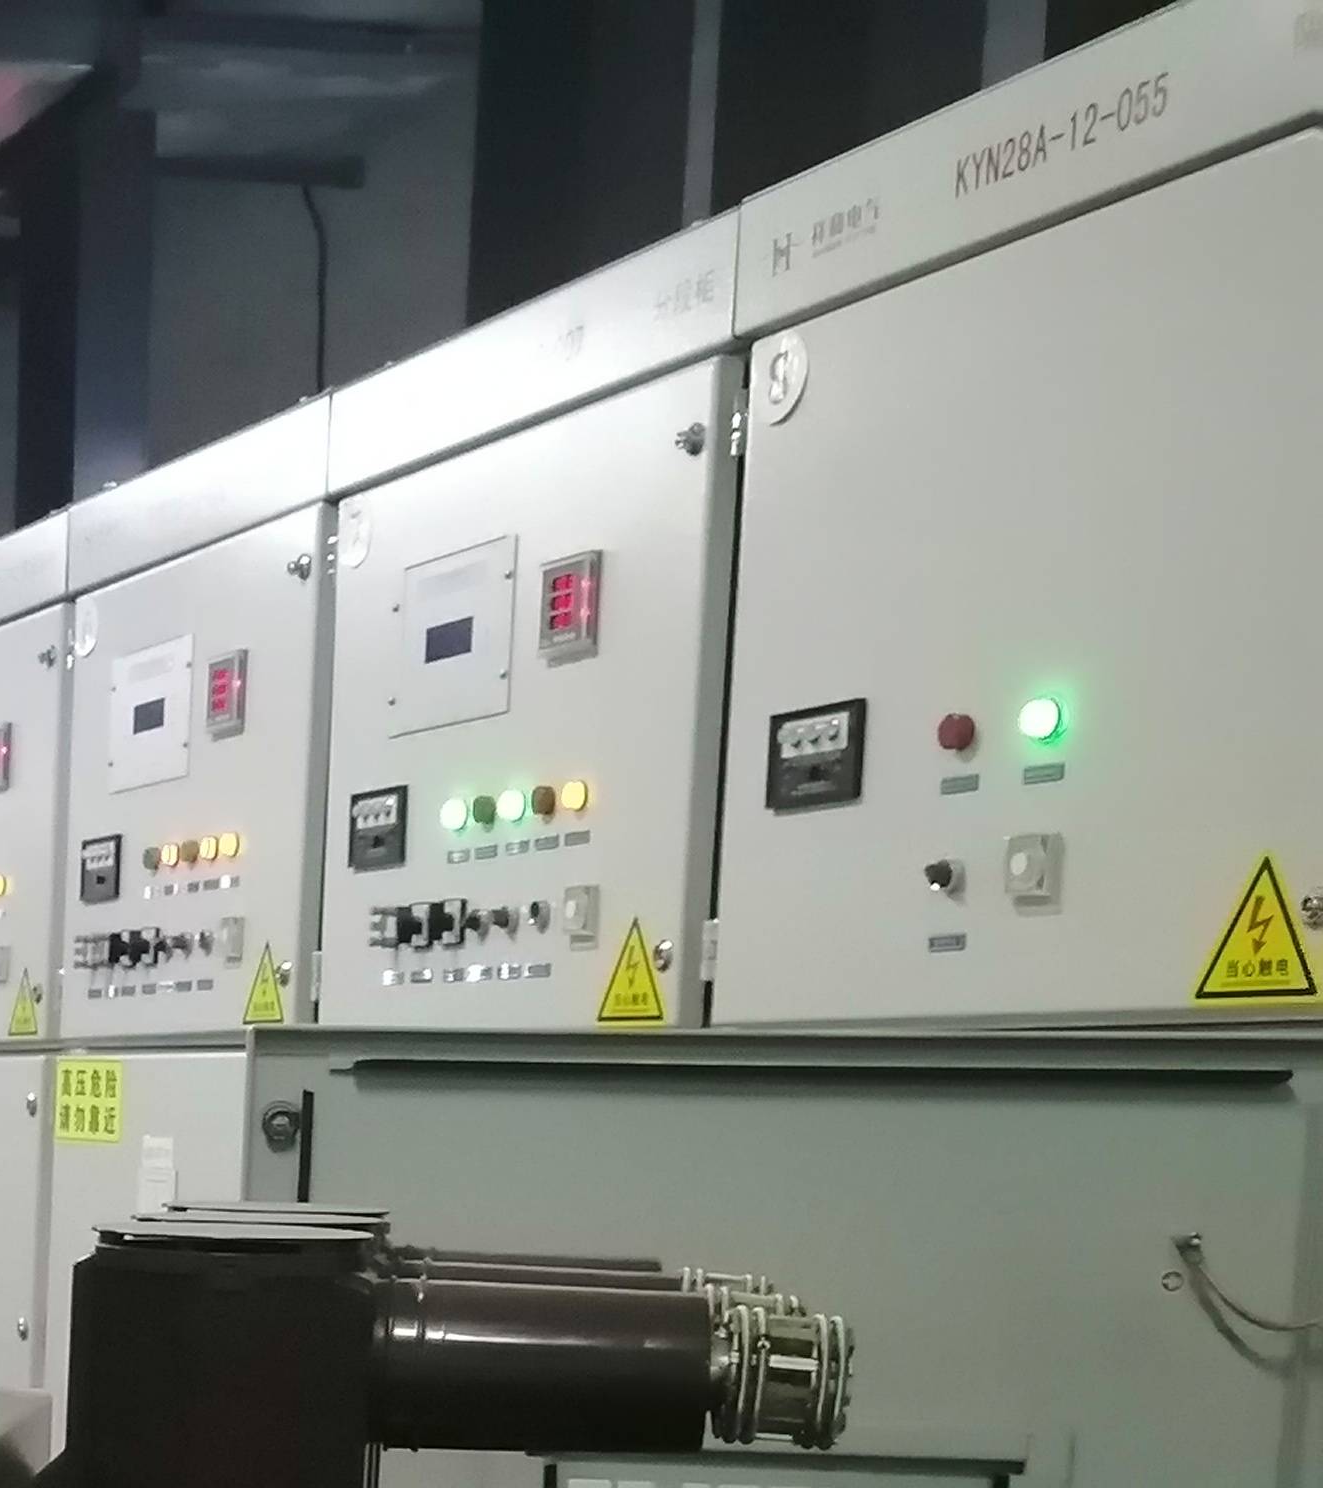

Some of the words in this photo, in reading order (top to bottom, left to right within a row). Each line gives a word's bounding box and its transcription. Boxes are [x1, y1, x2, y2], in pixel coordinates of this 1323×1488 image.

[955, 72, 1168, 198] KYN28A-12-055
[1226, 958, 1289, 978] 当心触电
[60, 1069, 117, 1098] 高压危险
[59, 1104, 116, 1135] 请勿靠近
